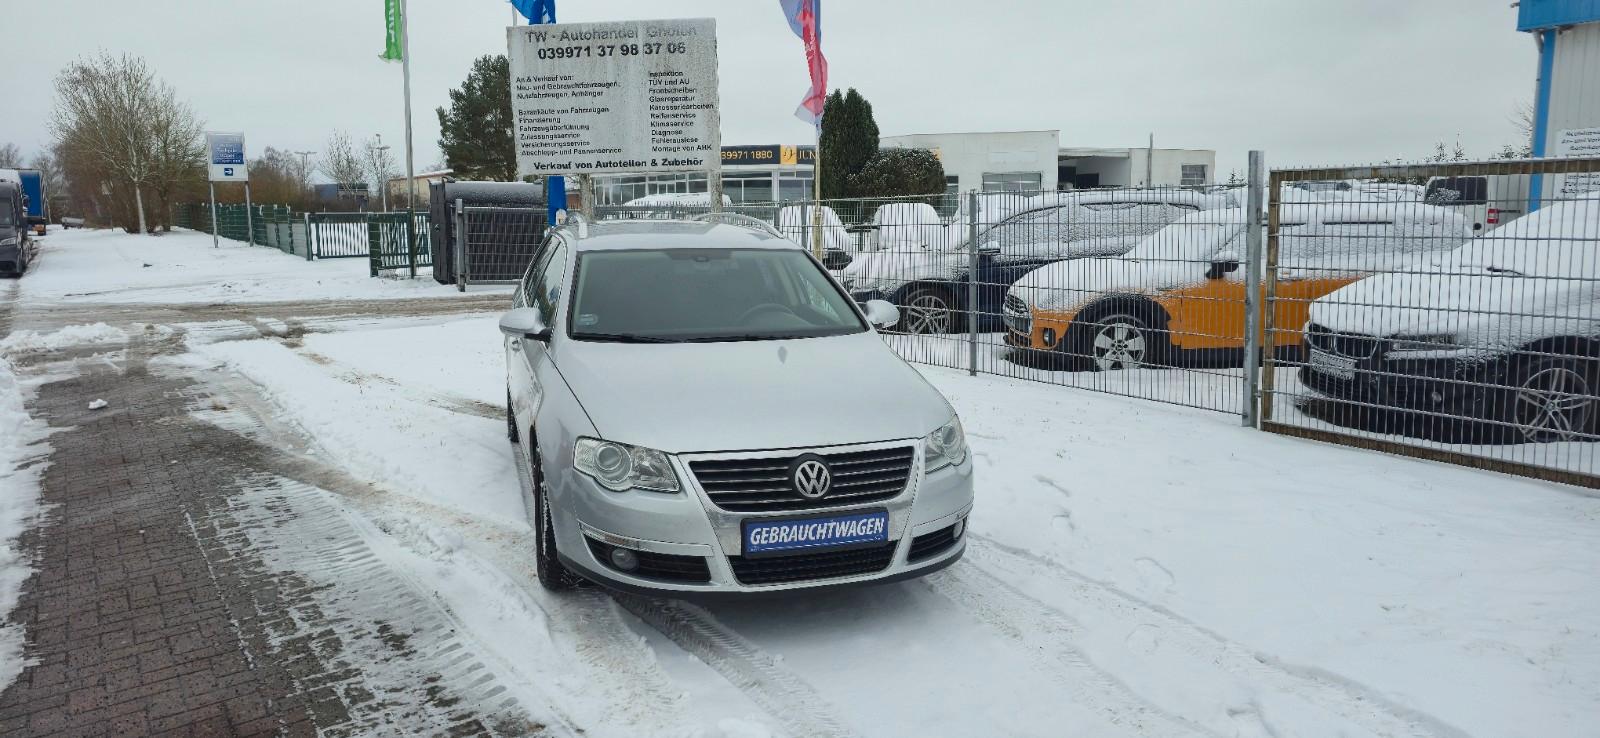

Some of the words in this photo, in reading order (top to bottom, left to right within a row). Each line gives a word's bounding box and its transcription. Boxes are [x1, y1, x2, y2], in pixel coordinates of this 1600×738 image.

[527, 31, 547, 43] TW
[559, 28, 639, 42] Autohandel
[537, 46, 591, 60] 039971
[597, 44, 615, 57] 37
[620, 44, 639, 56] 98
[644, 42, 662, 55] 37
[667, 41, 686, 54] 06
[516, 84, 532, 92] Neu-
[571, 90, 604, 98] Anhänger
[570, 107, 610, 115] Fahrzeugen
[649, 103, 714, 111] Karosseriearbeiten
[519, 116, 561, 124] Finanzierung
[519, 124, 590, 132] Fahrzeugüberführung
[651, 129, 683, 137] Diagnose
[521, 140, 590, 149] Versicherungsservice
[521, 149, 559, 157] Abschlepp-
[573, 147, 622, 155] Pannenservice
[651, 145, 681, 153] Montage
[751, 149, 773, 159] 1880
[534, 160, 573, 170] Verkauf
[575, 161, 592, 169] von
[595, 159, 647, 168] Autoteilen
[650, 158, 658, 166] &
[661, 157, 704, 167] Zubehör
[750, 517, 885, 545] GEBRAUCHTWAGEN
